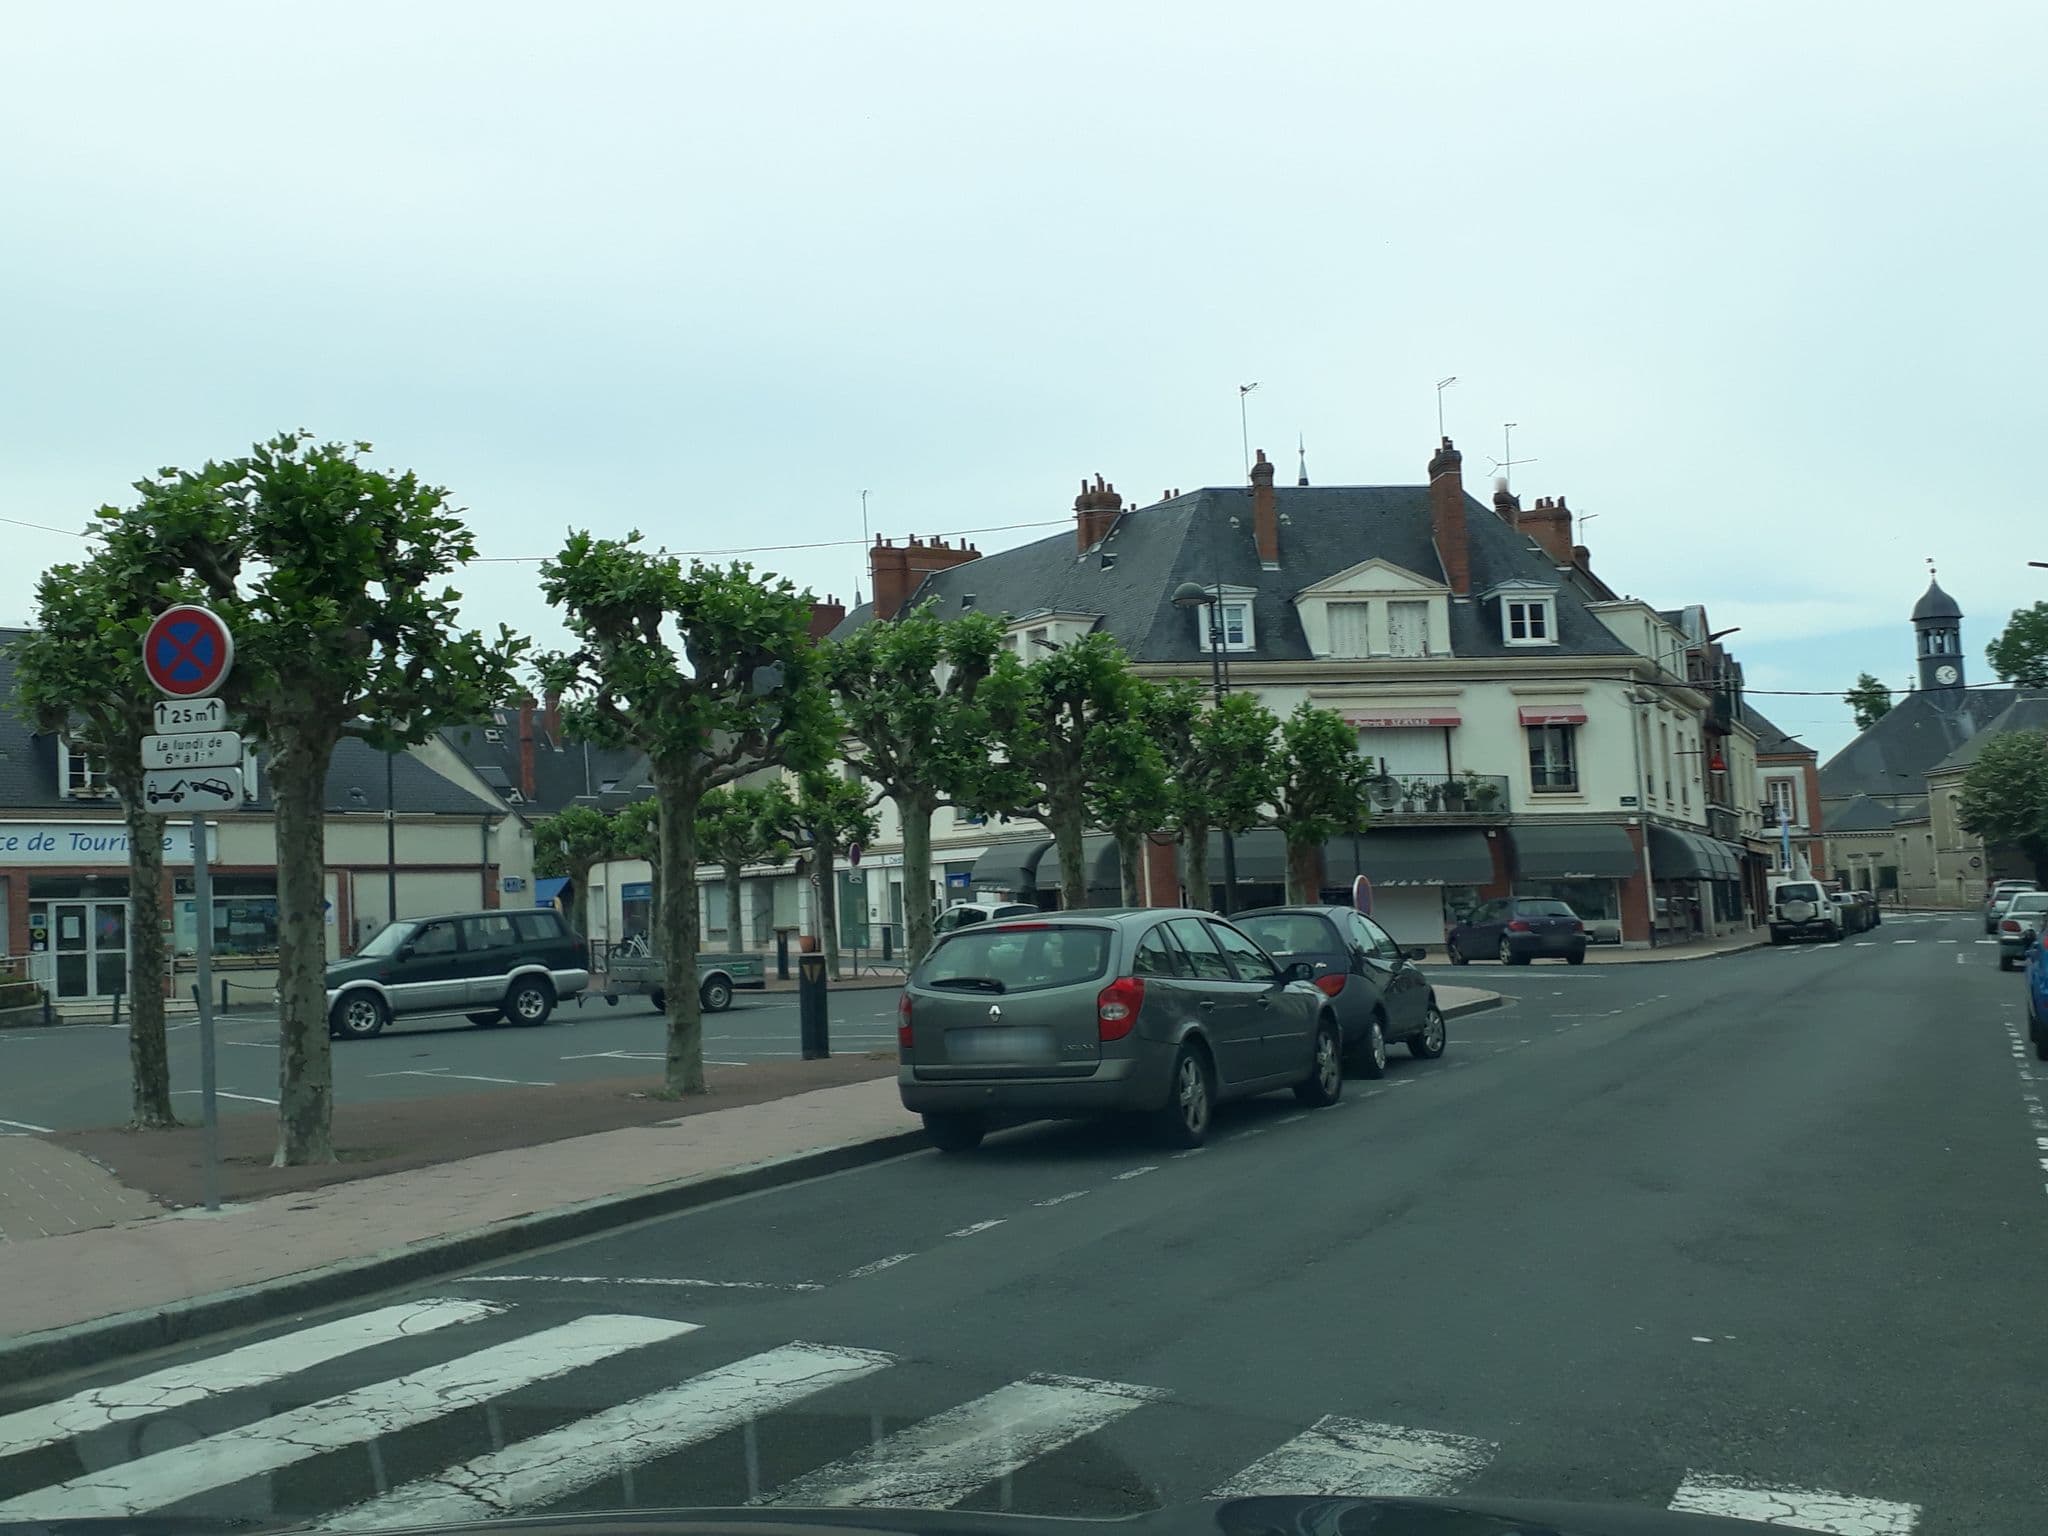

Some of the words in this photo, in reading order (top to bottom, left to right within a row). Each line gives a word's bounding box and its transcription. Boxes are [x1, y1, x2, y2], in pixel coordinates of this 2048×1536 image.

[156, 740, 169, 752] Le
[173, 737, 204, 750] lundi
[208, 735, 222, 748] de
[27, 831, 55, 851] de
[69, 832, 173, 851] Tourie
